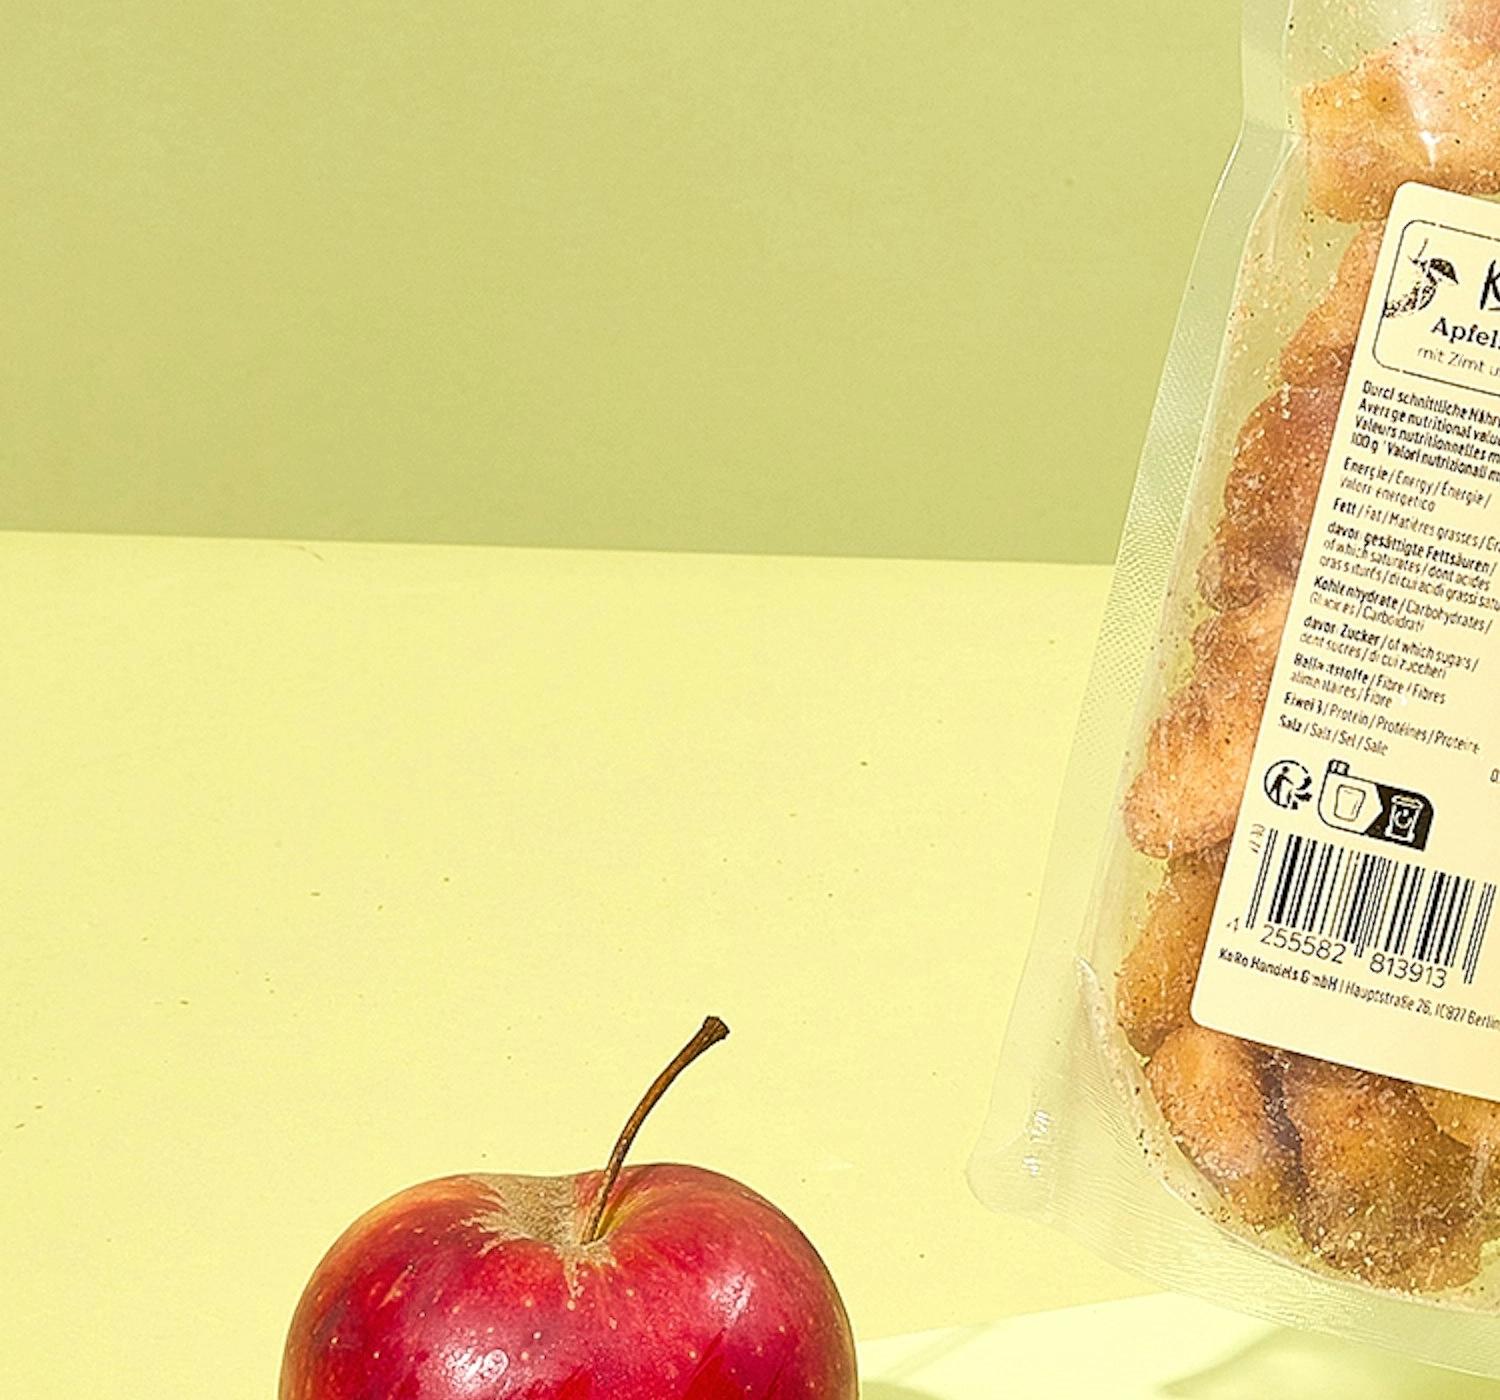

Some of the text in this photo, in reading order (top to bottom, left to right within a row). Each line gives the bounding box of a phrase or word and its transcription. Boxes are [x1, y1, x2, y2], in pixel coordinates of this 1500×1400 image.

[1417, 347, 1445, 364] mit
[1447, 350, 1485, 374] Zimt
[1355, 414, 1398, 439] Valeurs
[1406, 413, 1473, 440] nutritional
[1350, 431, 1372, 449] 100
[1386, 441, 1422, 463] Valori
[1332, 496, 1358, 517] Fett
[1339, 622, 1382, 647] Zucker
[1259, 923, 1452, 989] 255582 813913
